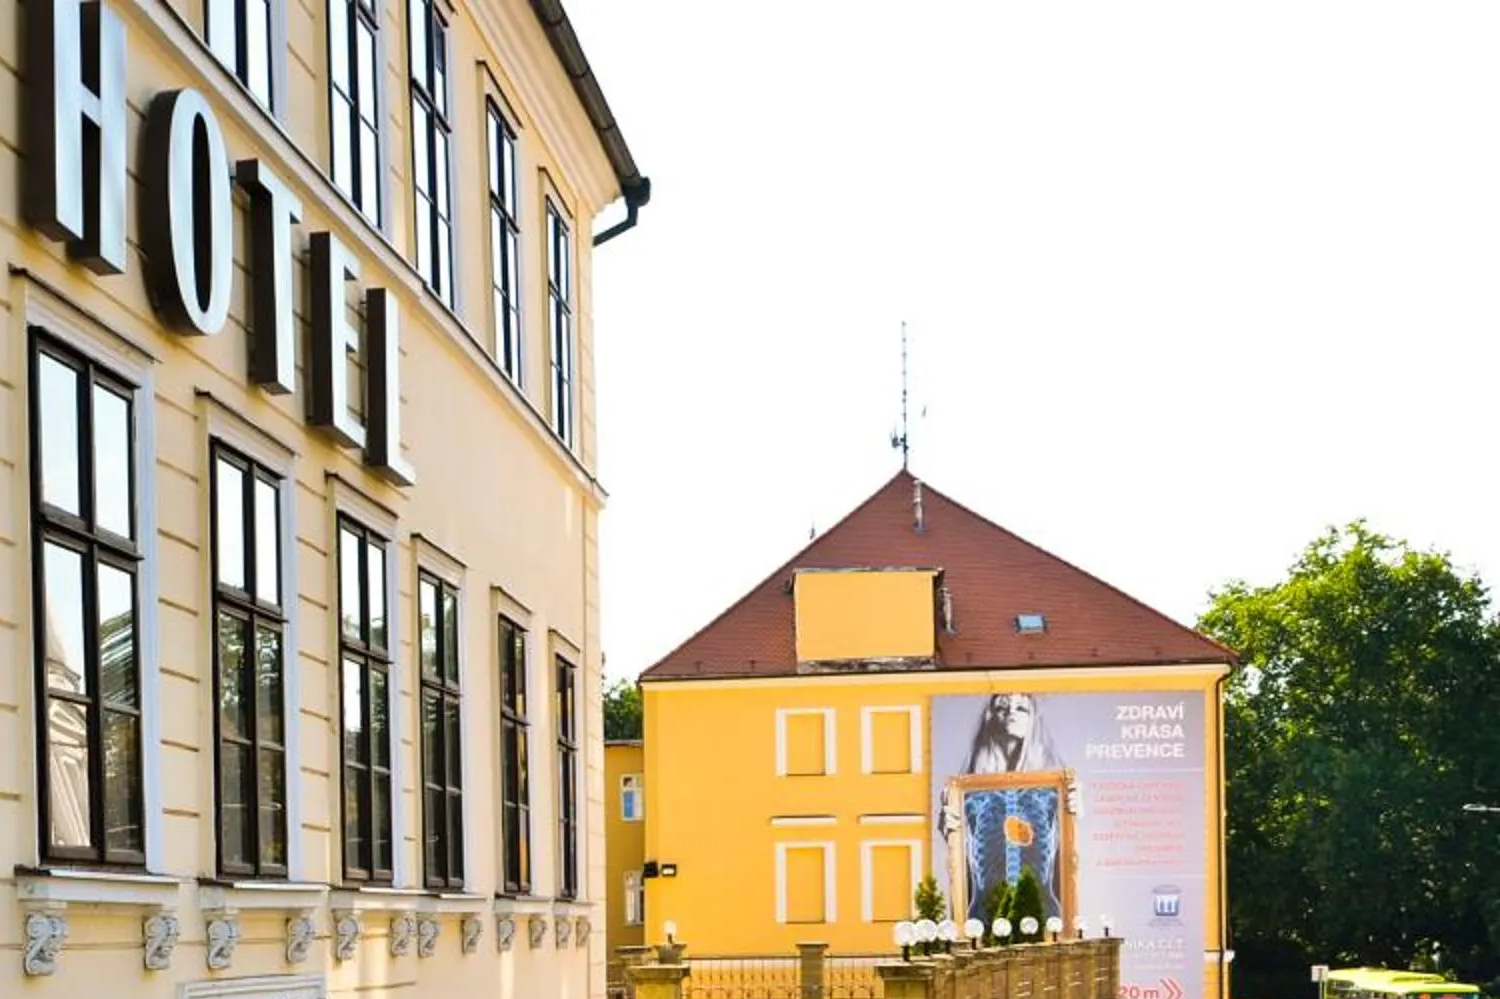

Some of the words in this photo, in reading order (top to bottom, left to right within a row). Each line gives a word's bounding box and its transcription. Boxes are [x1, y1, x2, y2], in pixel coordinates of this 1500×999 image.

[28, 0, 416, 486] HOTEL
[1115, 701, 1185, 720] ZDRAVÍ
[1085, 742, 1185, 759] PREVENCE
